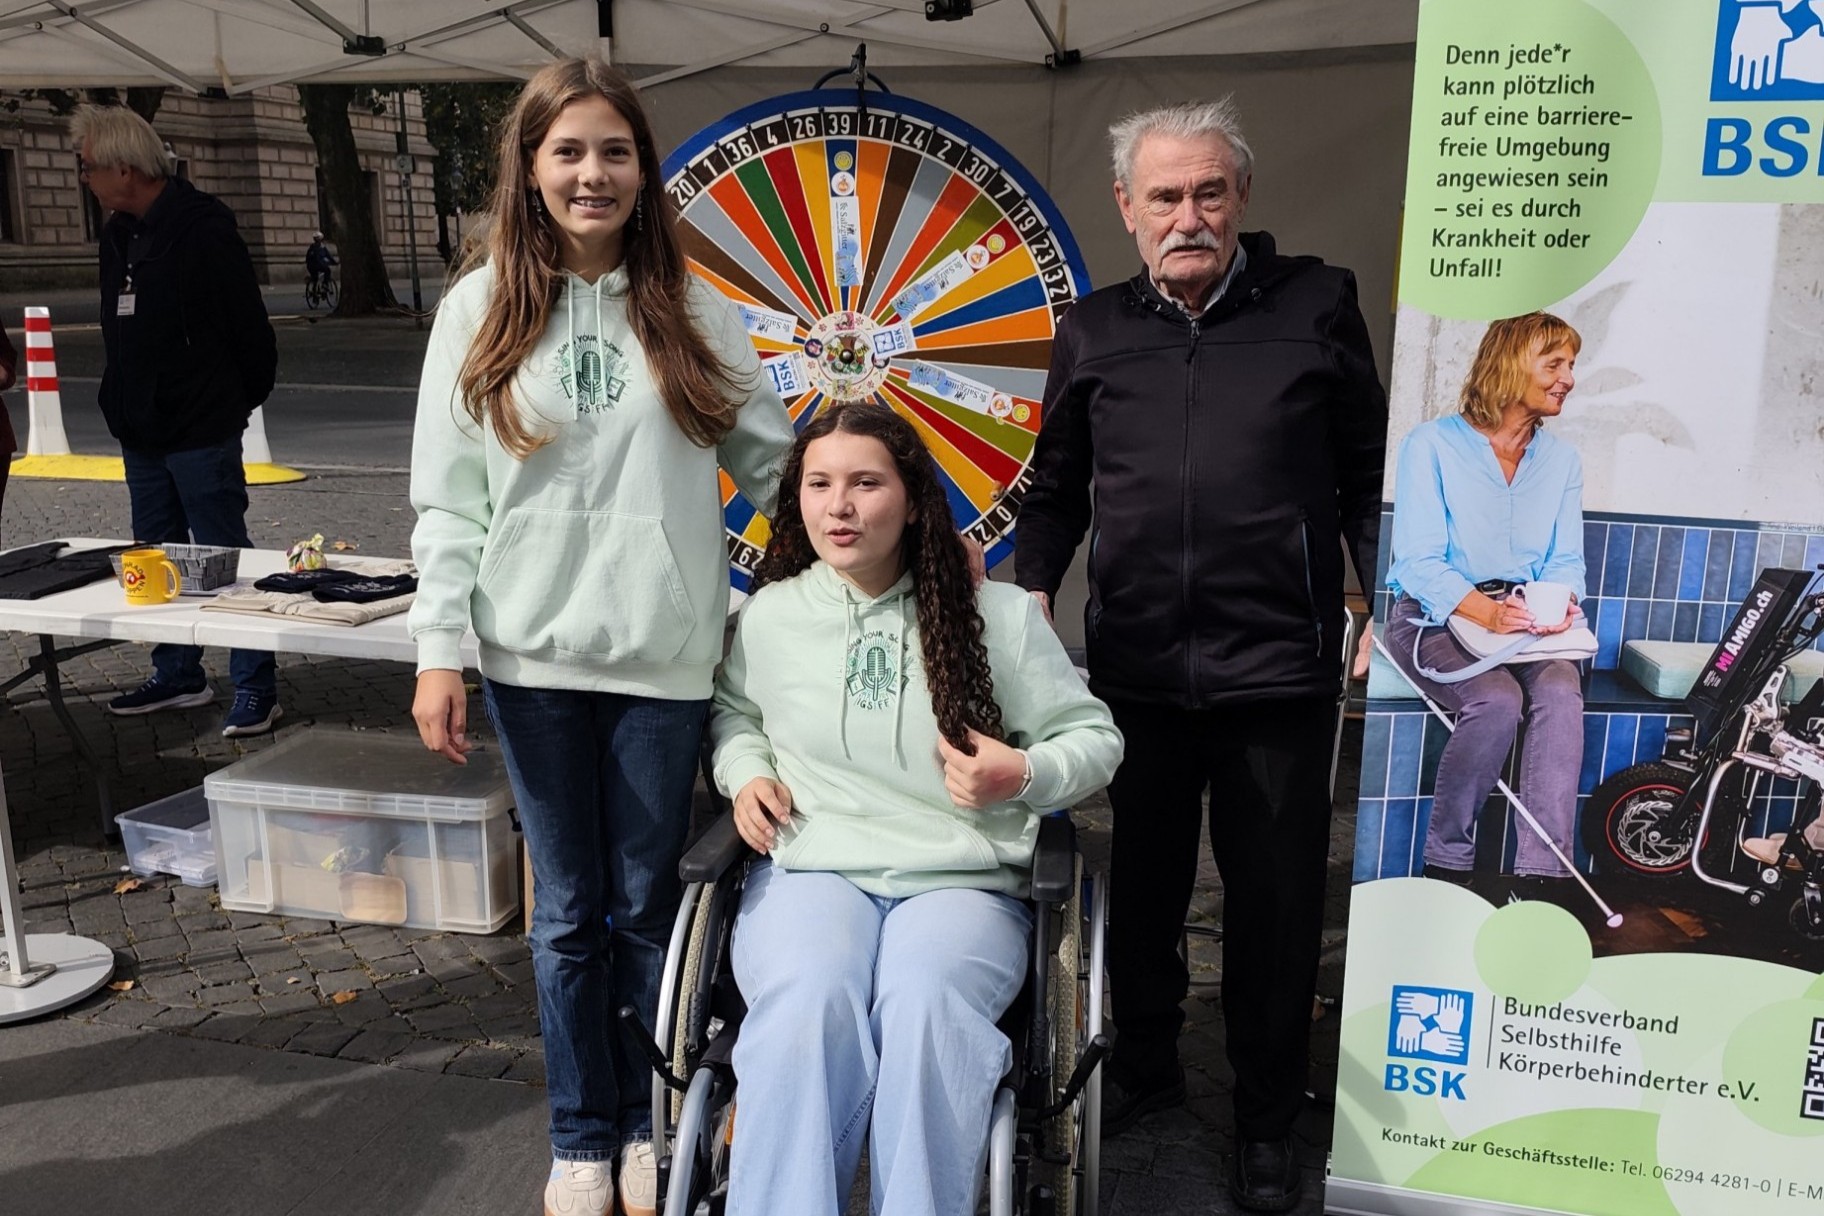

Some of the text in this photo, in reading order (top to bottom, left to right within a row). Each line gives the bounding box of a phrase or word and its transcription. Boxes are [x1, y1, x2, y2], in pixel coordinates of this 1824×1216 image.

[1446, 45, 1500, 65] Denn
[1443, 74, 1595, 101] kann plötzlich
[793, 116, 816, 138] 26
[828, 114, 850, 135] 39
[868, 115, 887, 138] 11
[1440, 105, 1633, 127] auf eine barriere-
[766, 126, 778, 145] 4
[901, 124, 925, 149] 24
[1702, 116, 1824, 178] BS
[726, 137, 753, 162] 36
[937, 140, 951, 160] 2
[1439, 137, 1610, 163] freie Umgebung
[703, 158, 718, 177] 1
[965, 157, 989, 182] 30
[671, 178, 695, 206] 20
[994, 183, 1013, 199] 7
[1436, 168, 1608, 193] angewiesen sein
[1013, 206, 1036, 231] 19
[1455, 198, 1484, 218] sei
[1491, 203, 1513, 218] es
[1521, 198, 1581, 218] durch
[1031, 238, 1055, 264] 23
[1432, 229, 1591, 249] Krankheit oder
[1430, 258, 1502, 278] Unfall!
[1044, 269, 1068, 297] 32
[576, 335, 598, 343] YOUR
[893, 328, 905, 349] BSK
[777, 360, 795, 391] BSK
[996, 505, 1012, 522] 0
[863, 630, 884, 640] YOUR
[1715, 590, 1774, 672] MIAMIGO.ch
[1504, 996, 1679, 1034] Bundesverband
[1501, 1024, 1622, 1057] Selbsthilfe
[1384, 1063, 1468, 1100] BSK
[1499, 1052, 1759, 1102] Körperbehinderter e.V.
[1382, 1128, 1824, 1200] Kontakt zur Geschäftsstelle: Tel. 06294 4281-0 E-M
